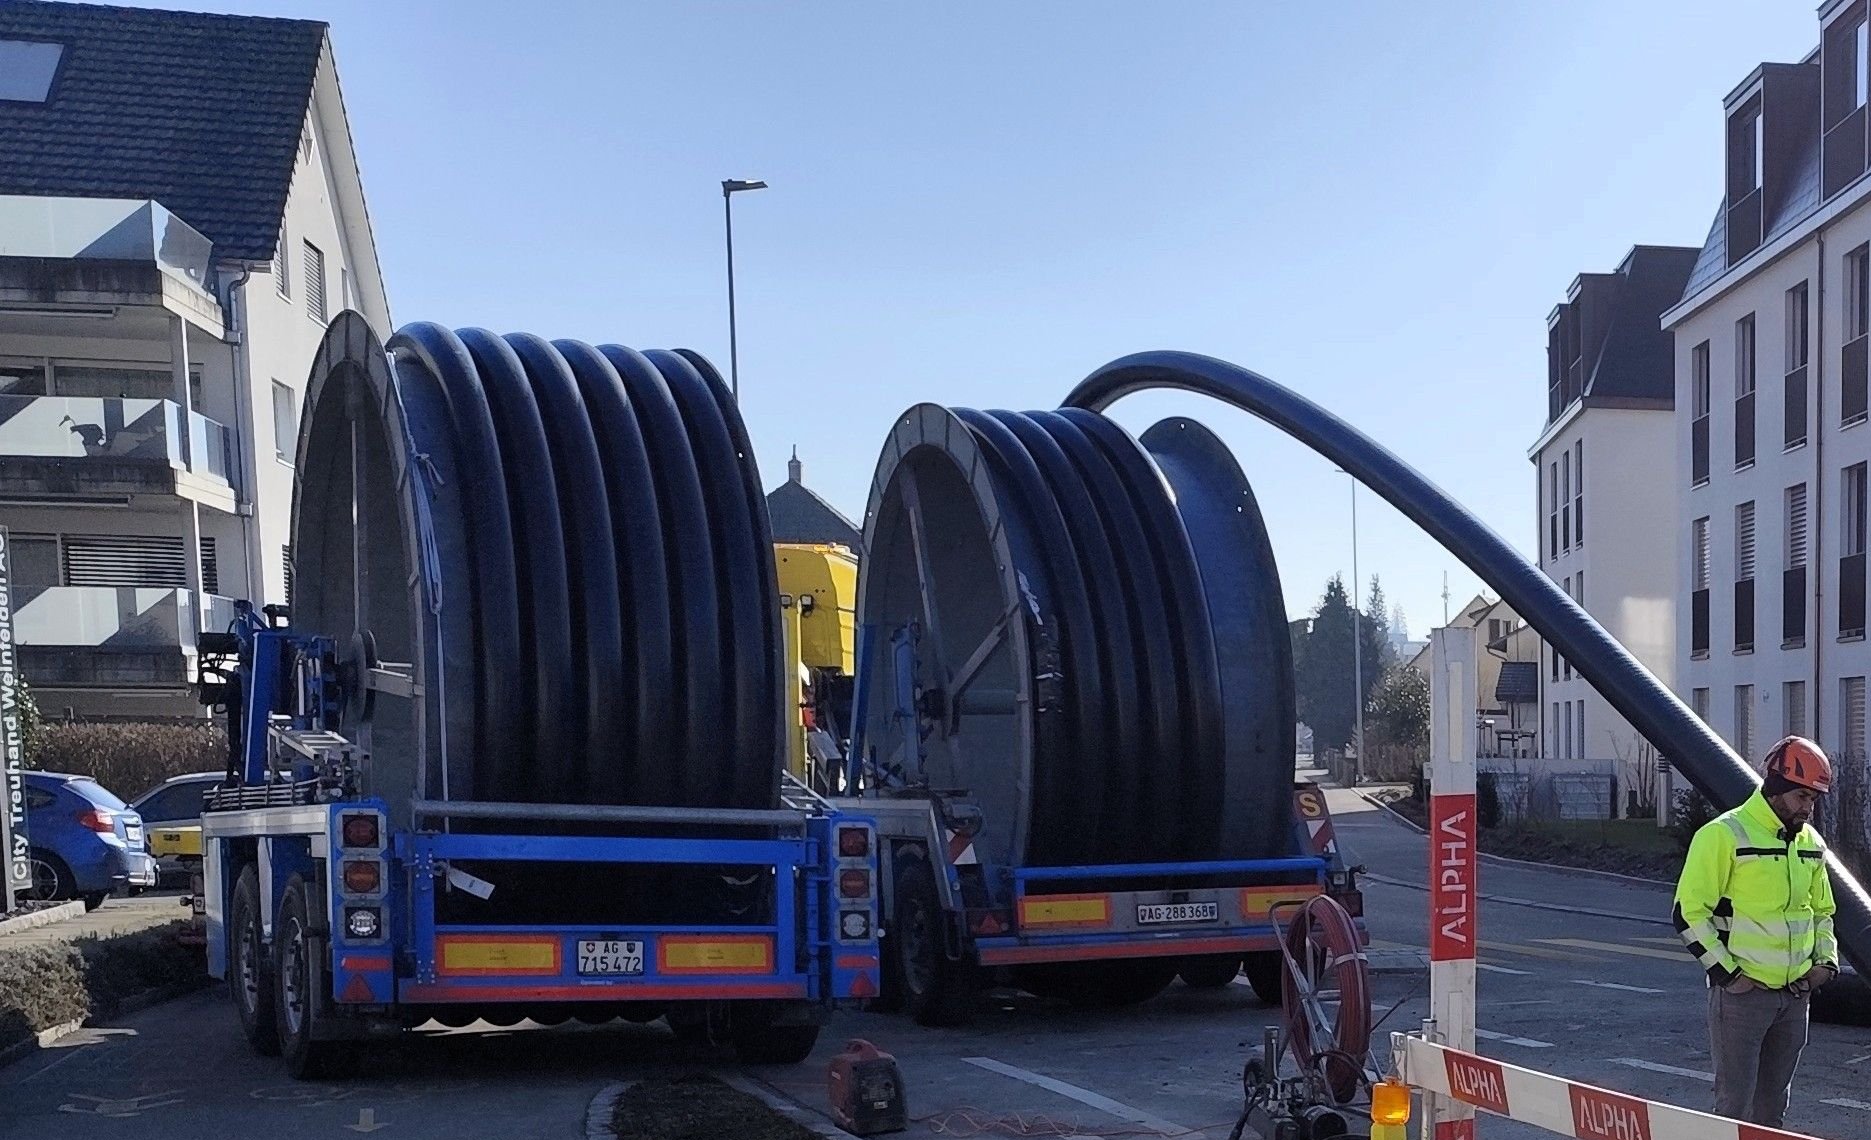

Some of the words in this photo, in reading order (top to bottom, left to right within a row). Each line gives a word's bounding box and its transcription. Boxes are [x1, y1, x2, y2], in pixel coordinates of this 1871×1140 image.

[3, 716, 24, 828] Treuhand
[13, 833, 29, 880] City
[1441, 810, 1467, 948] ALPHA
[603, 943, 619, 954] AG
[1452, 1060, 1502, 1105] ALPHA
